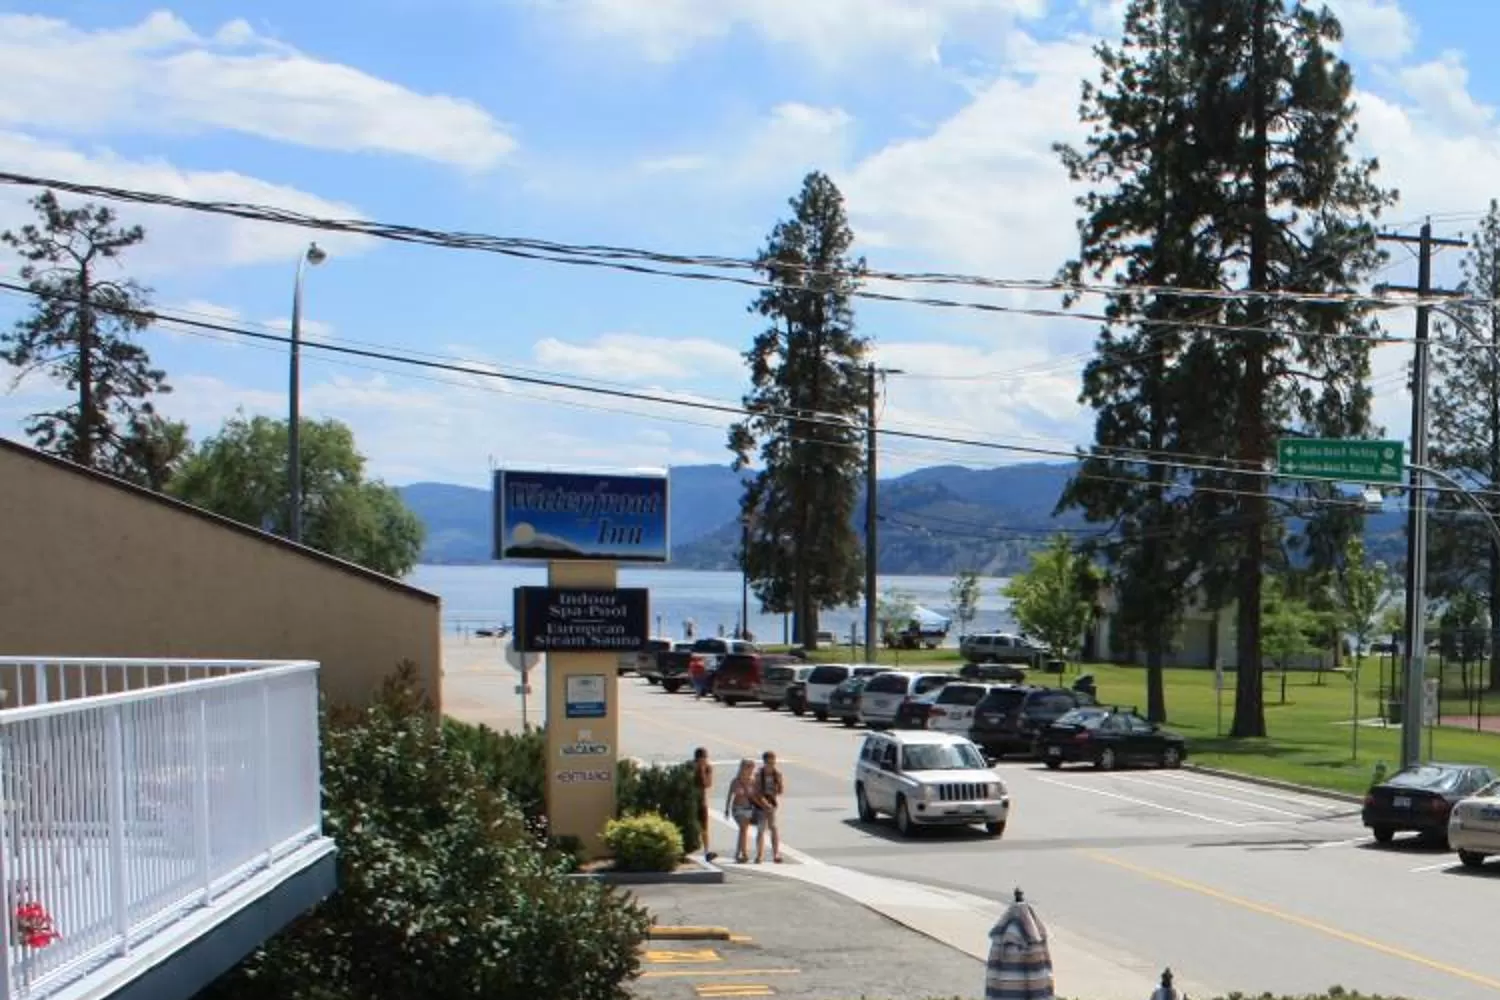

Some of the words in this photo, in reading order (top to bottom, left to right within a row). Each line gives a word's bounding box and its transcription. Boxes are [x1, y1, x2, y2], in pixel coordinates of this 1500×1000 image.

[509, 481, 660, 519] Waterfront
[597, 517, 643, 545] Inn
[560, 592, 616, 605] Indoor
[546, 622, 625, 638] European
[534, 634, 586, 646] Steam
[590, 635, 642, 646] Sauna
